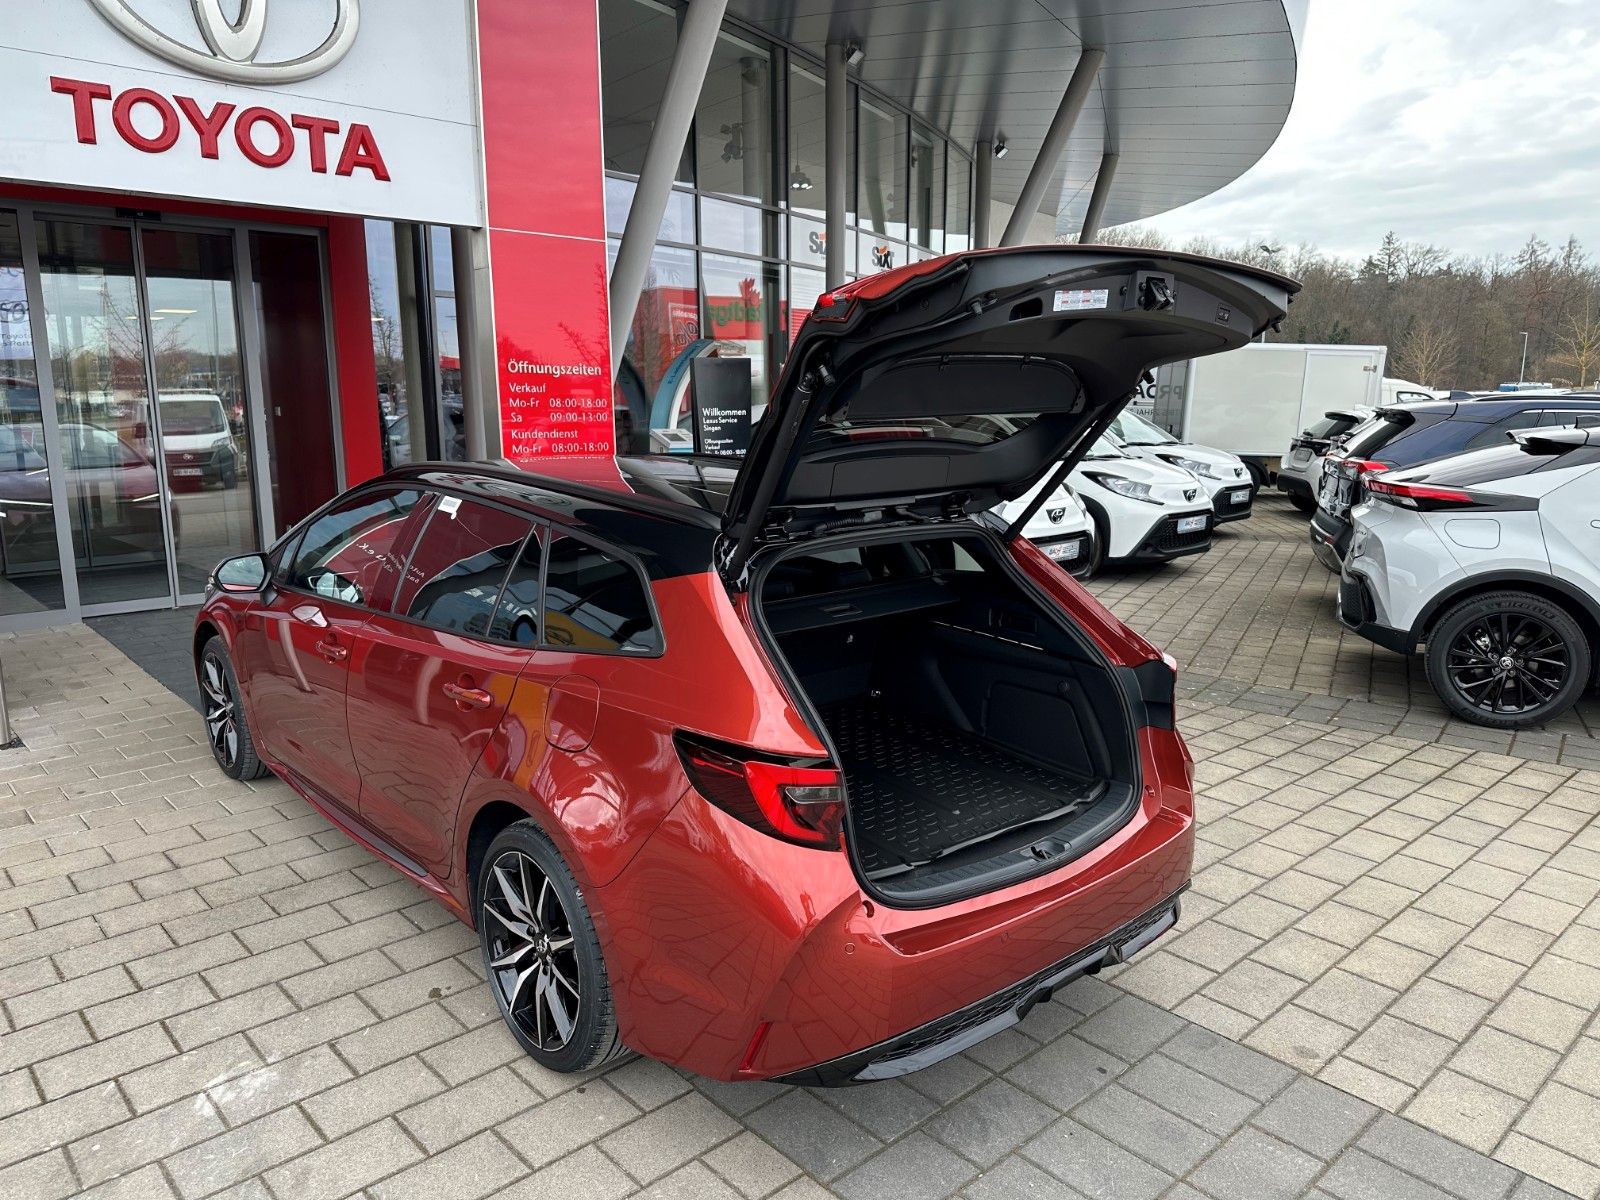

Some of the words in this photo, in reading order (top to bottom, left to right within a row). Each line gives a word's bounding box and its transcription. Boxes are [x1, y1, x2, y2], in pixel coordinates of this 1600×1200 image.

[50, 75, 391, 182] TOYOTA
[507, 358, 602, 377] Öffnungszeiten
[508, 383, 546, 393] Verkauf
[509, 398, 540, 408] Mo-Fr
[549, 398, 607, 408] 08:00-18:00
[702, 407, 747, 417] Willkommen
[510, 412, 523, 423] Sa
[550, 412, 608, 422] 09:00-13:00
[718, 416, 738, 424] Service
[703, 424, 722, 432] Singen
[511, 429, 578, 440] Kundendienst
[512, 444, 542, 454] Mo-Fr
[551, 442, 609, 453] 08:00-18:00
